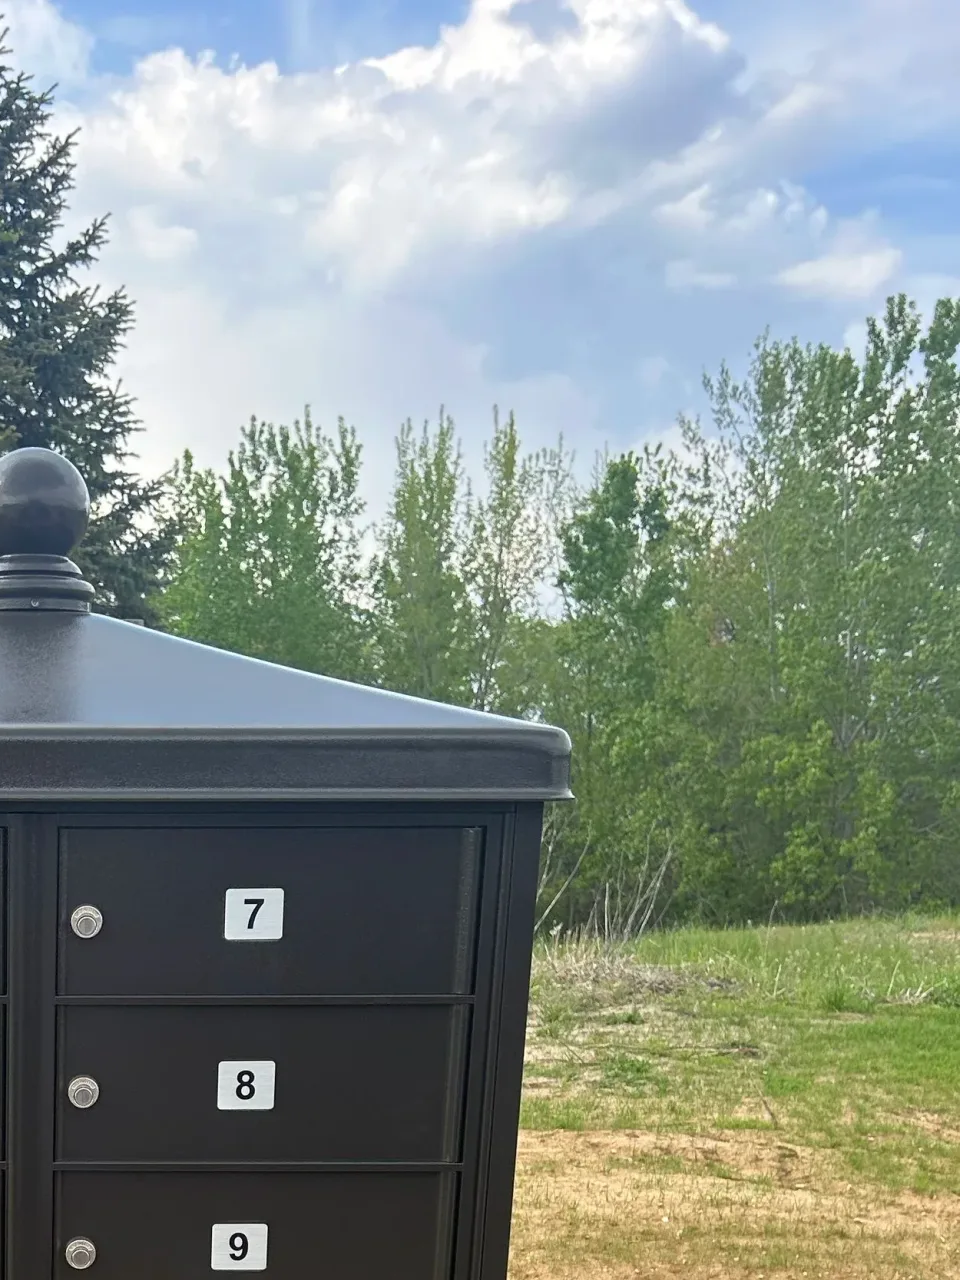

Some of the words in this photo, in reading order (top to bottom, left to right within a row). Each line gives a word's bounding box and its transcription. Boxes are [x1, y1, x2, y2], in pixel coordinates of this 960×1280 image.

[244, 899, 264, 929] 7
[236, 1071, 255, 1100] 8
[229, 1233, 248, 1260] 9
